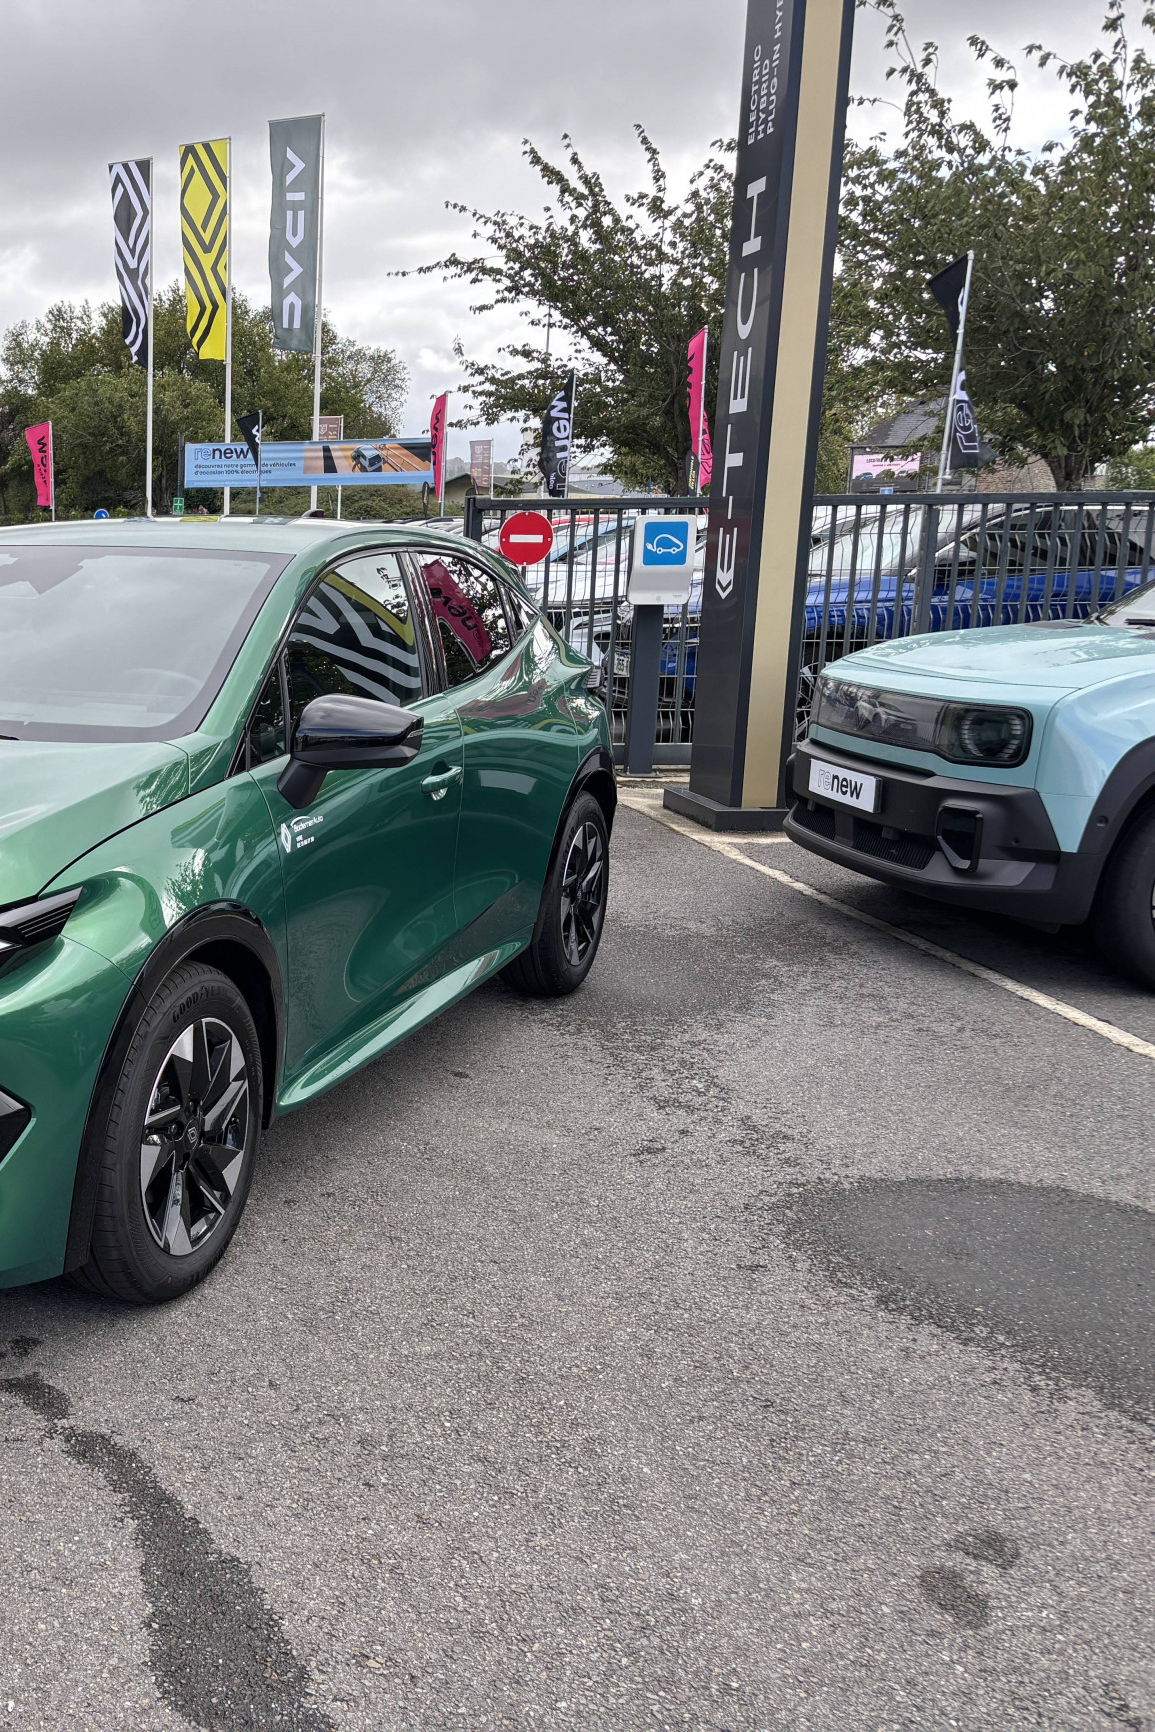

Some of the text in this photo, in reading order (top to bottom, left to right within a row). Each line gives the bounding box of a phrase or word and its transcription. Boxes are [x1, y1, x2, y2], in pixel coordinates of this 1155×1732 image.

[748, 44, 762, 145] ELECTRIC
[757, 59, 769, 140] HYBRID
[767, 43, 781, 134] PLUG-IN
[716, 176, 767, 599] E-TECH
[195, 447, 250, 460] renew
[818, 769, 863, 800] renew
